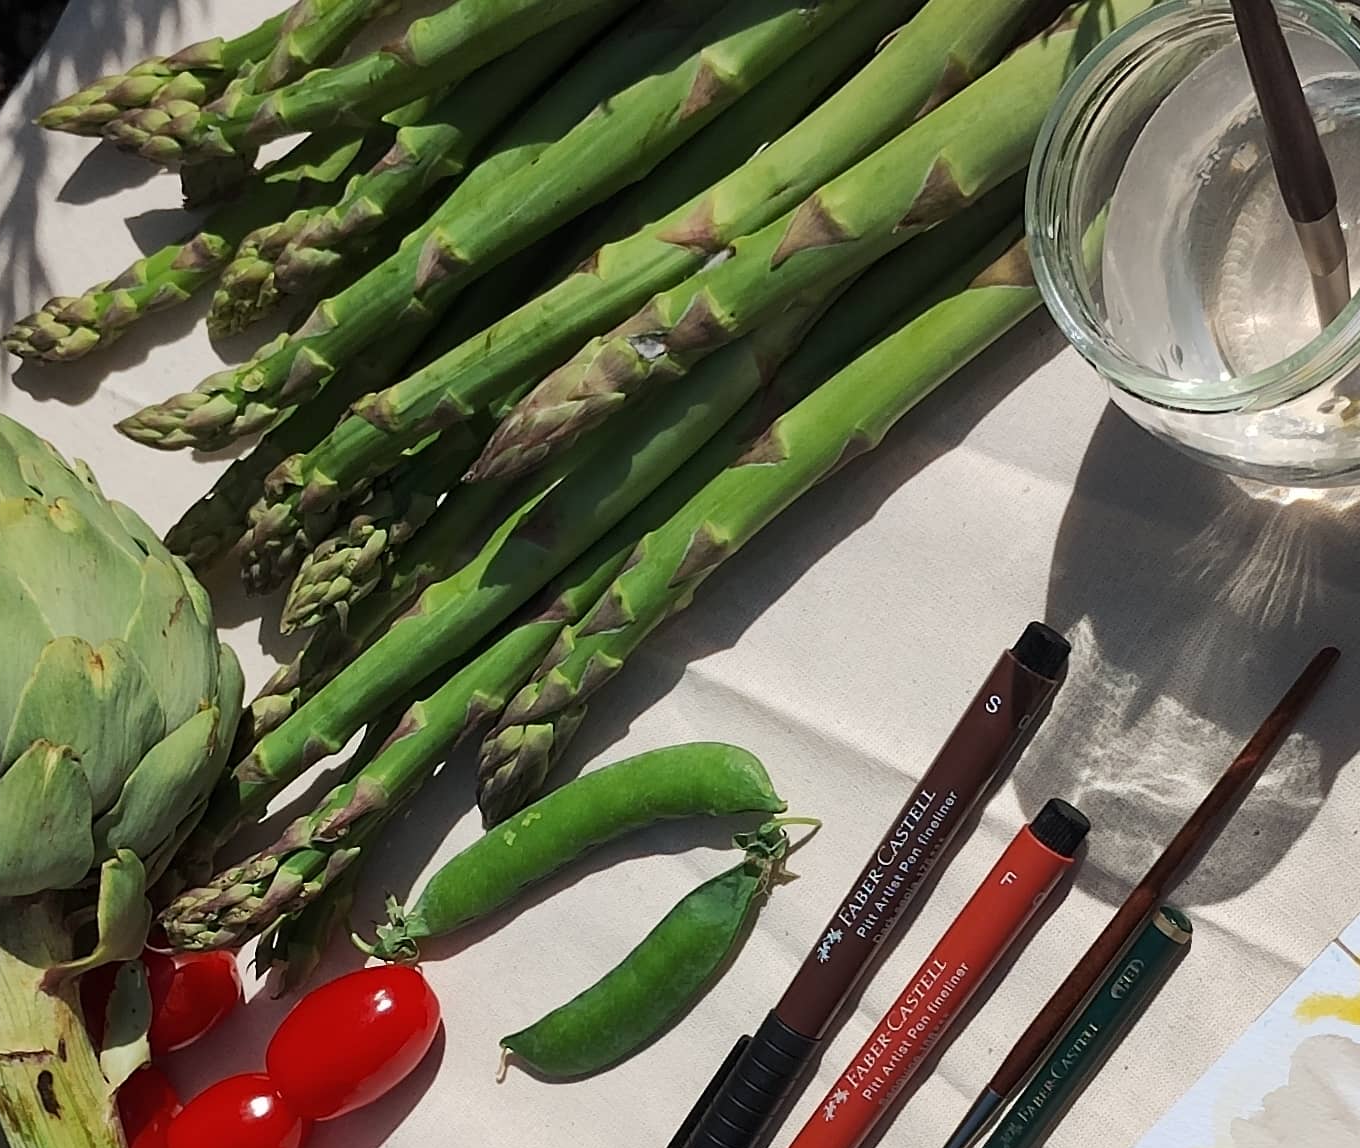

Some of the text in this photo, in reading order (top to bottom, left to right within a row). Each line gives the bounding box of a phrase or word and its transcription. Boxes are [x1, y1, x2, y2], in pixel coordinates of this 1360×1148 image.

[838, 789, 936, 927] FABER-CASTELL
[856, 791, 958, 938] Pitt Artist Pen fineliner
[1000, 871, 1017, 885] F
[845, 959, 946, 1089] FABER-CASTELL
[862, 1075, 885, 1100] Pitt
[882, 1041, 912, 1076] Artist
[907, 1015, 930, 1039] Pen
[927, 962, 969, 1014] fineliner
